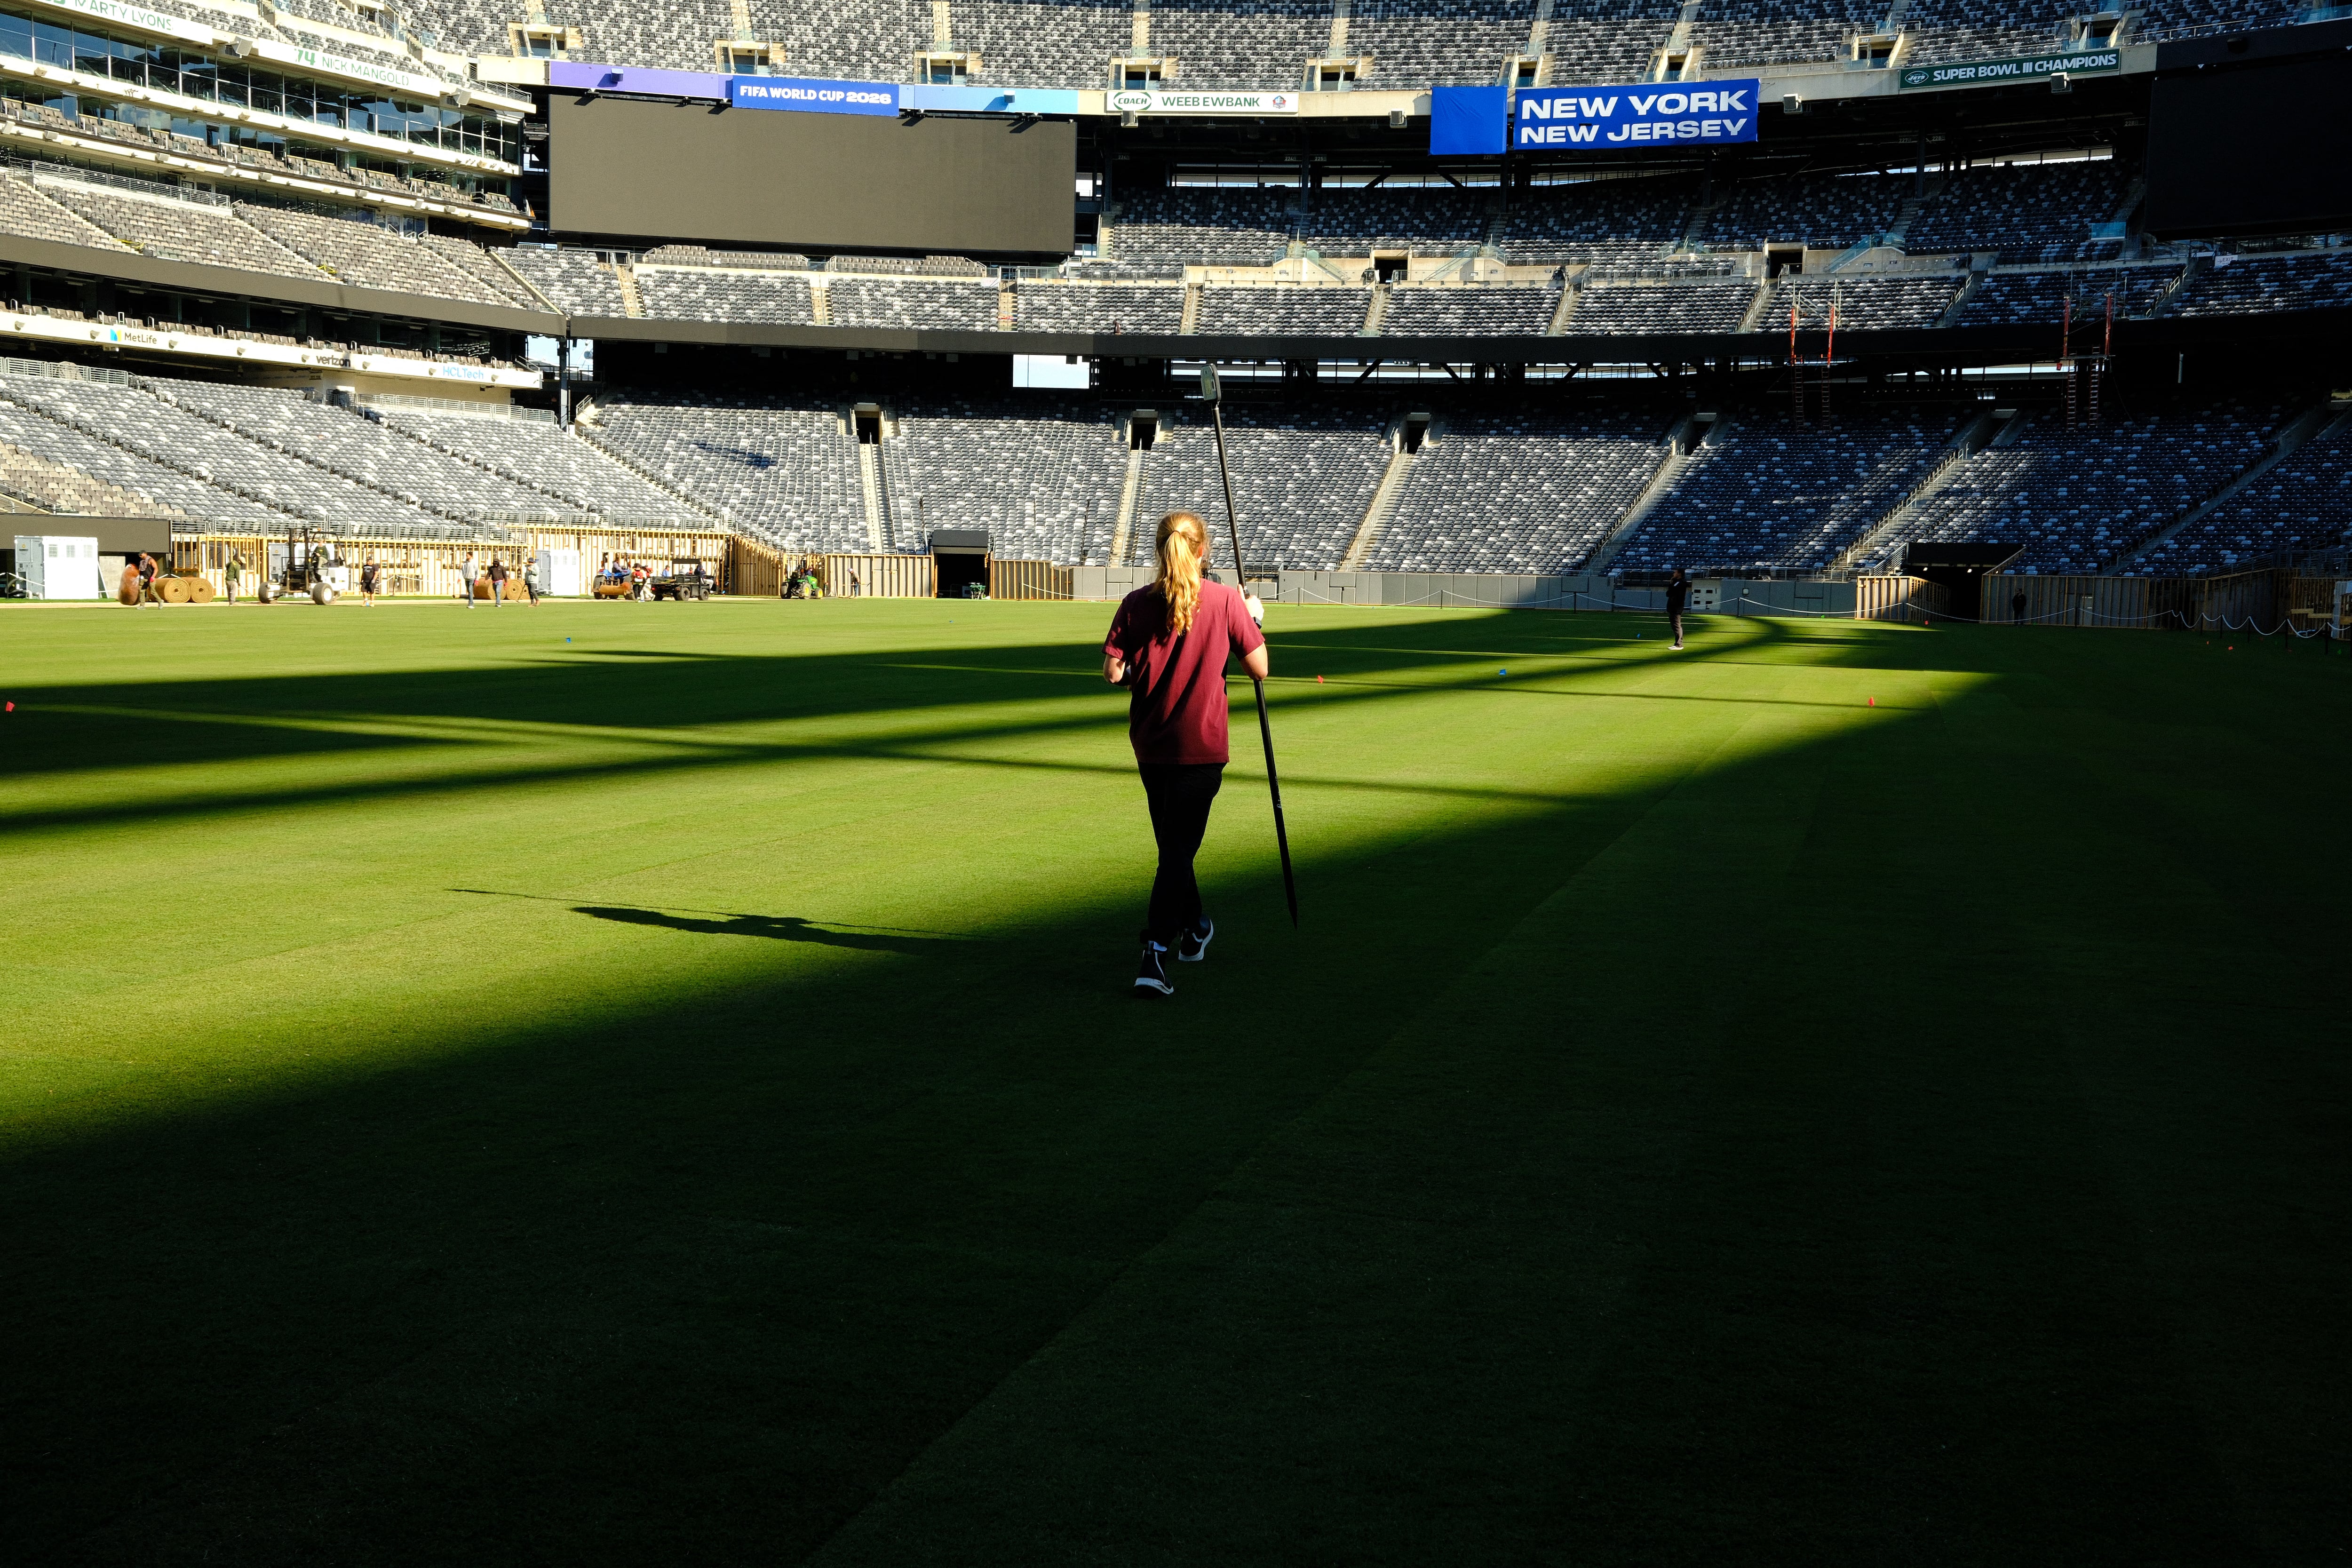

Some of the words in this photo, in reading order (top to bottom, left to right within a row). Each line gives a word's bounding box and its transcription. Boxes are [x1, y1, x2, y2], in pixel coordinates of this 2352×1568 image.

[75, 0, 127, 19] MARTY
[132, 8, 173, 31] LYONS
[294, 48, 316, 65] 74
[322, 56, 348, 72] NICK
[351, 63, 409, 86] MANGOLD
[1933, 67, 1975, 81] SUPER
[1978, 64, 2021, 77] BOWL
[2023, 62, 2033, 73] III
[2034, 54, 2117, 72] CHAMPIONS
[740, 86, 768, 97] FIFA
[769, 87, 817, 100] WORLD
[818, 90, 845, 102] CUP
[846, 91, 892, 104] 2026
[1162, 96, 1200, 106] WEEB
[1203, 97, 1260, 107] EWBANK
[1522, 96, 1619, 119] NEW
[1628, 90, 1748, 115] YORK
[1521, 124, 1599, 143] NEW
[1607, 118, 1748, 142] JERSEY
[125, 332, 157, 344] MetLife
[316, 355, 351, 367] verizon
[443, 366, 484, 380] HCLTech
